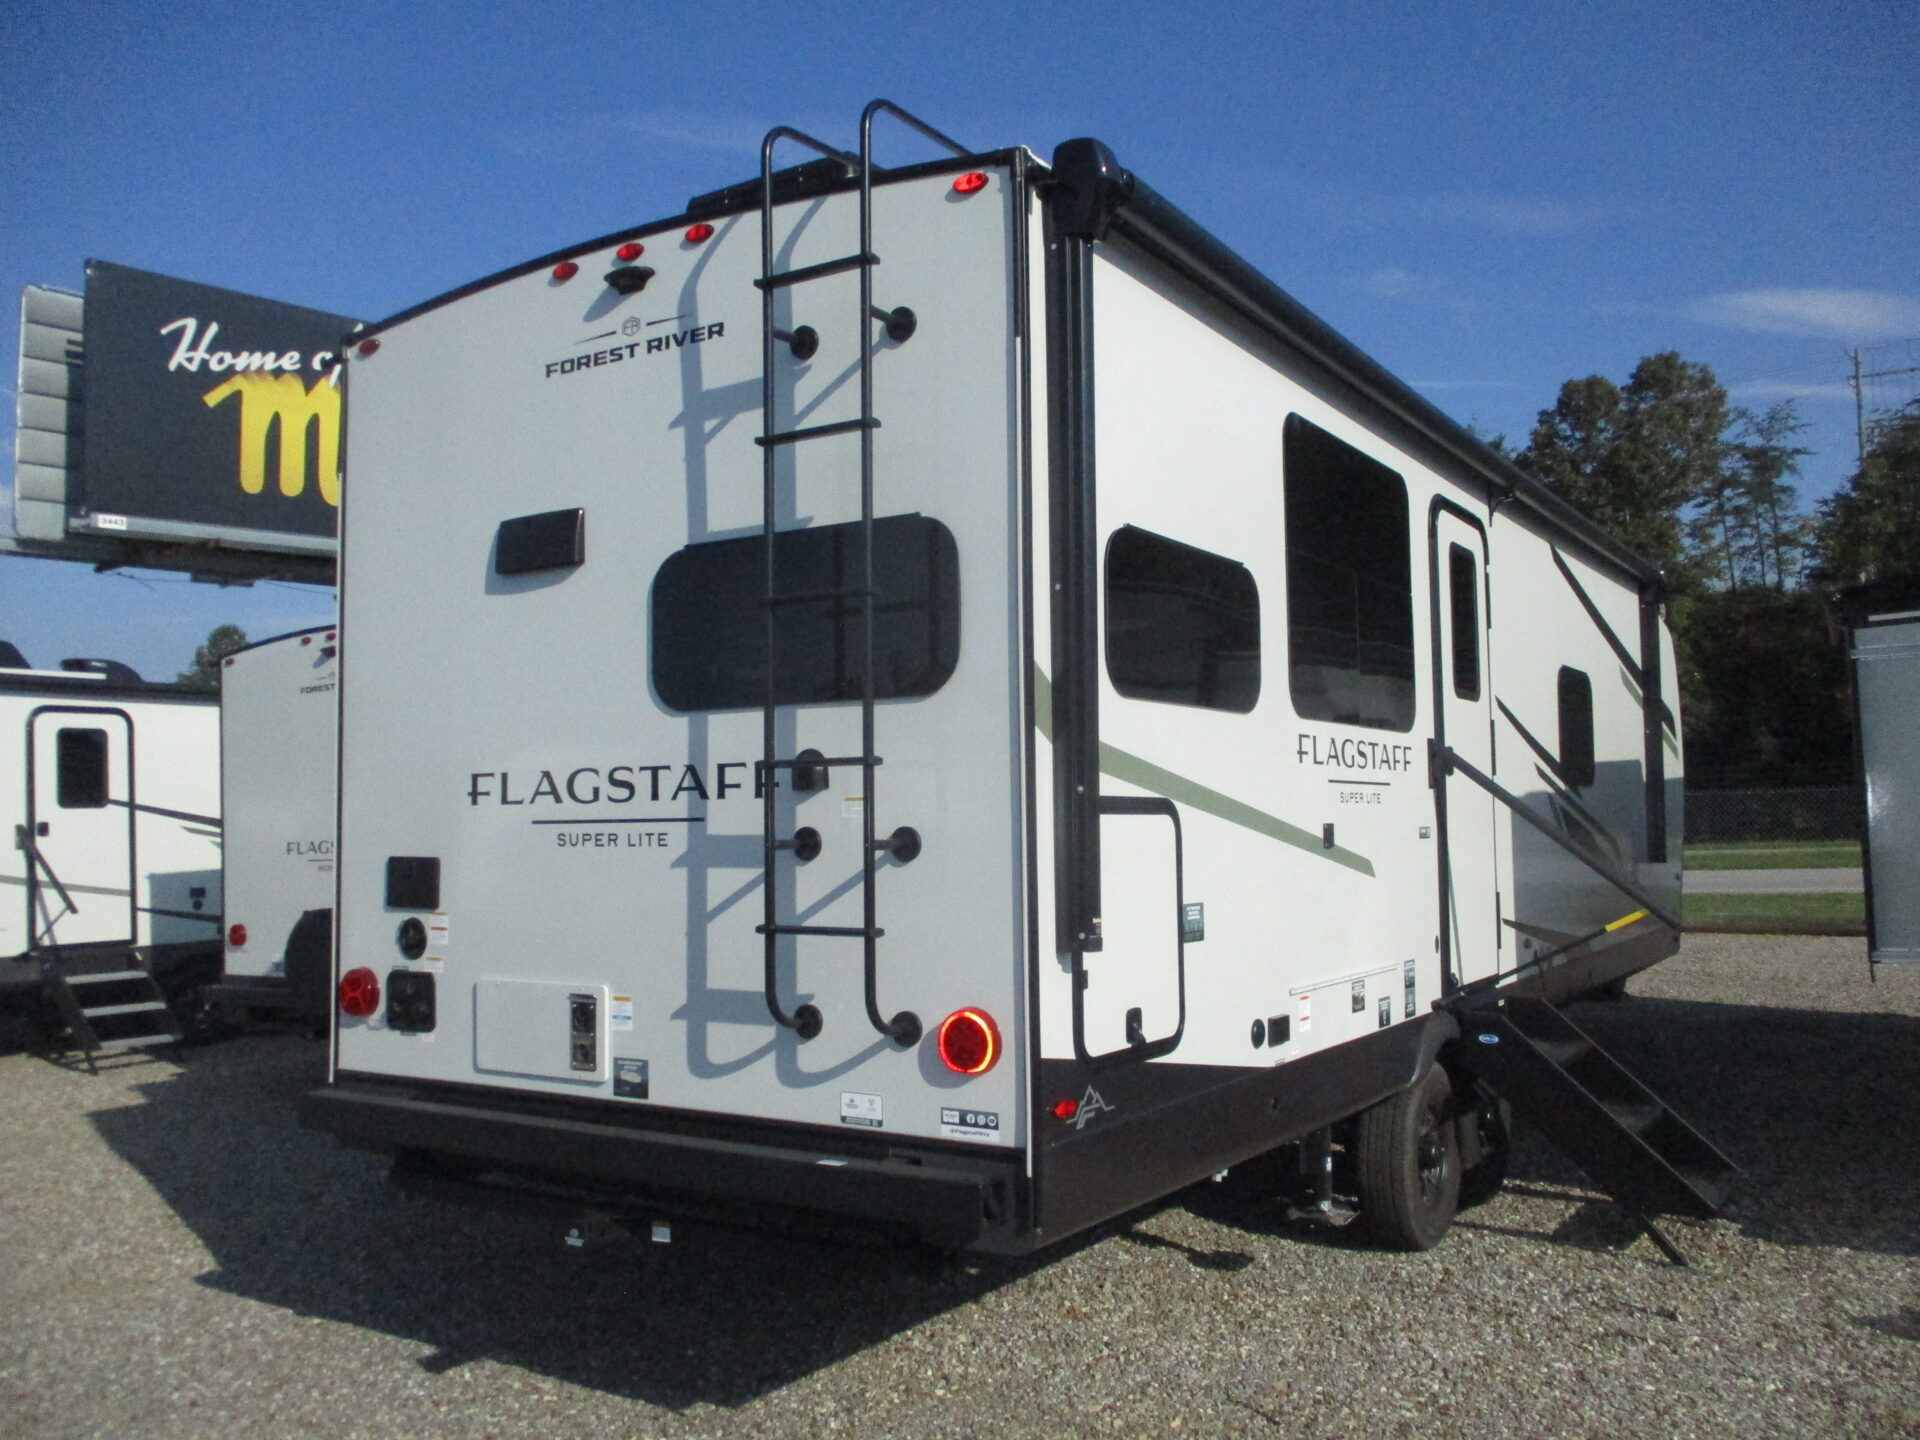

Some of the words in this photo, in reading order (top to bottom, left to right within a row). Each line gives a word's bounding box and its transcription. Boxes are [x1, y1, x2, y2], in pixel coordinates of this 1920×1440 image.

[160, 317, 301, 372] Home
[545, 342, 640, 378] FOREST
[646, 322, 725, 355] RIVER
[1297, 733, 1412, 771] FLAGSTAFF
[1340, 792, 1364, 803] SUPER
[1366, 793, 1382, 804] LITE
[557, 833, 618, 848] SUPER
[627, 832, 669, 847] LITE
